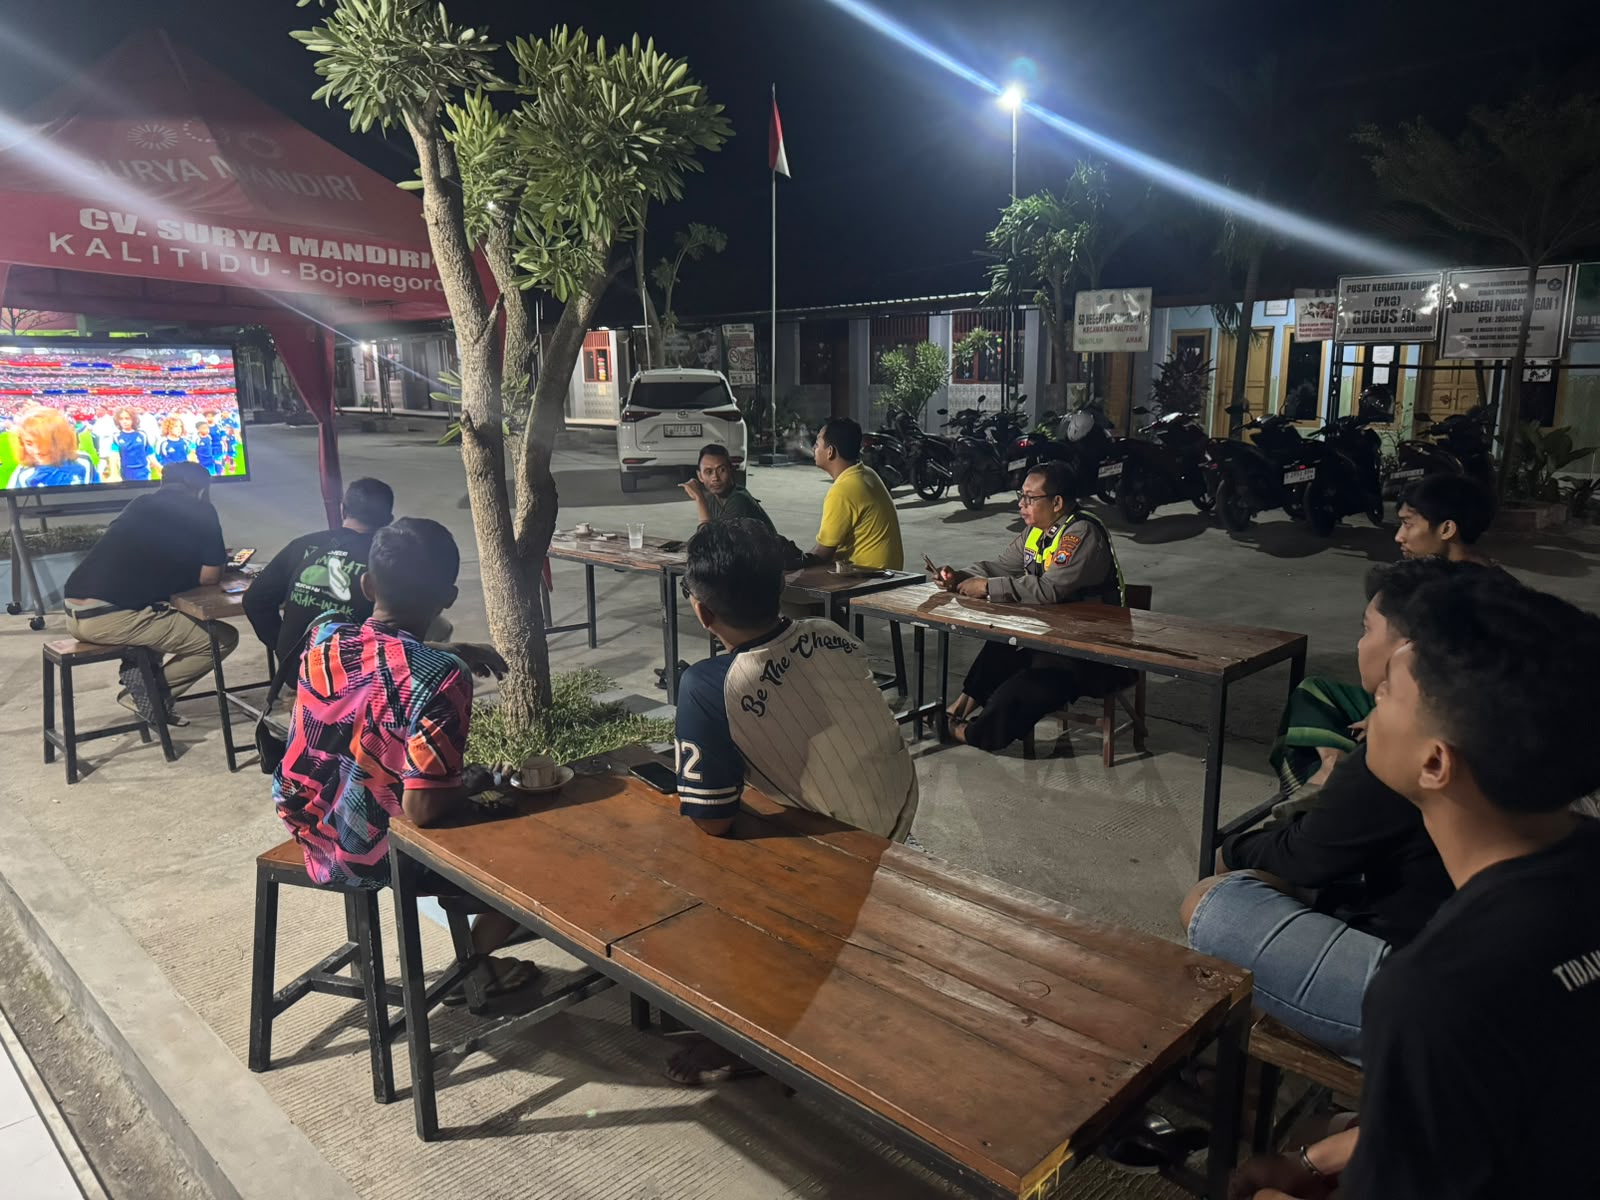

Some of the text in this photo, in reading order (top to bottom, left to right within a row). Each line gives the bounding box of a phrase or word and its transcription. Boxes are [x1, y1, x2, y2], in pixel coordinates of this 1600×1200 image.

[214, 155, 366, 201] MANDIRI
[49, 231, 271, 277] KALITIDU
[79, 207, 431, 270] CV. SURYA MANDIRI
[1372, 282, 1409, 292] KEGIATAN
[1353, 309, 1397, 325] GUGUS
[740, 632, 859, 718] Be The Change
